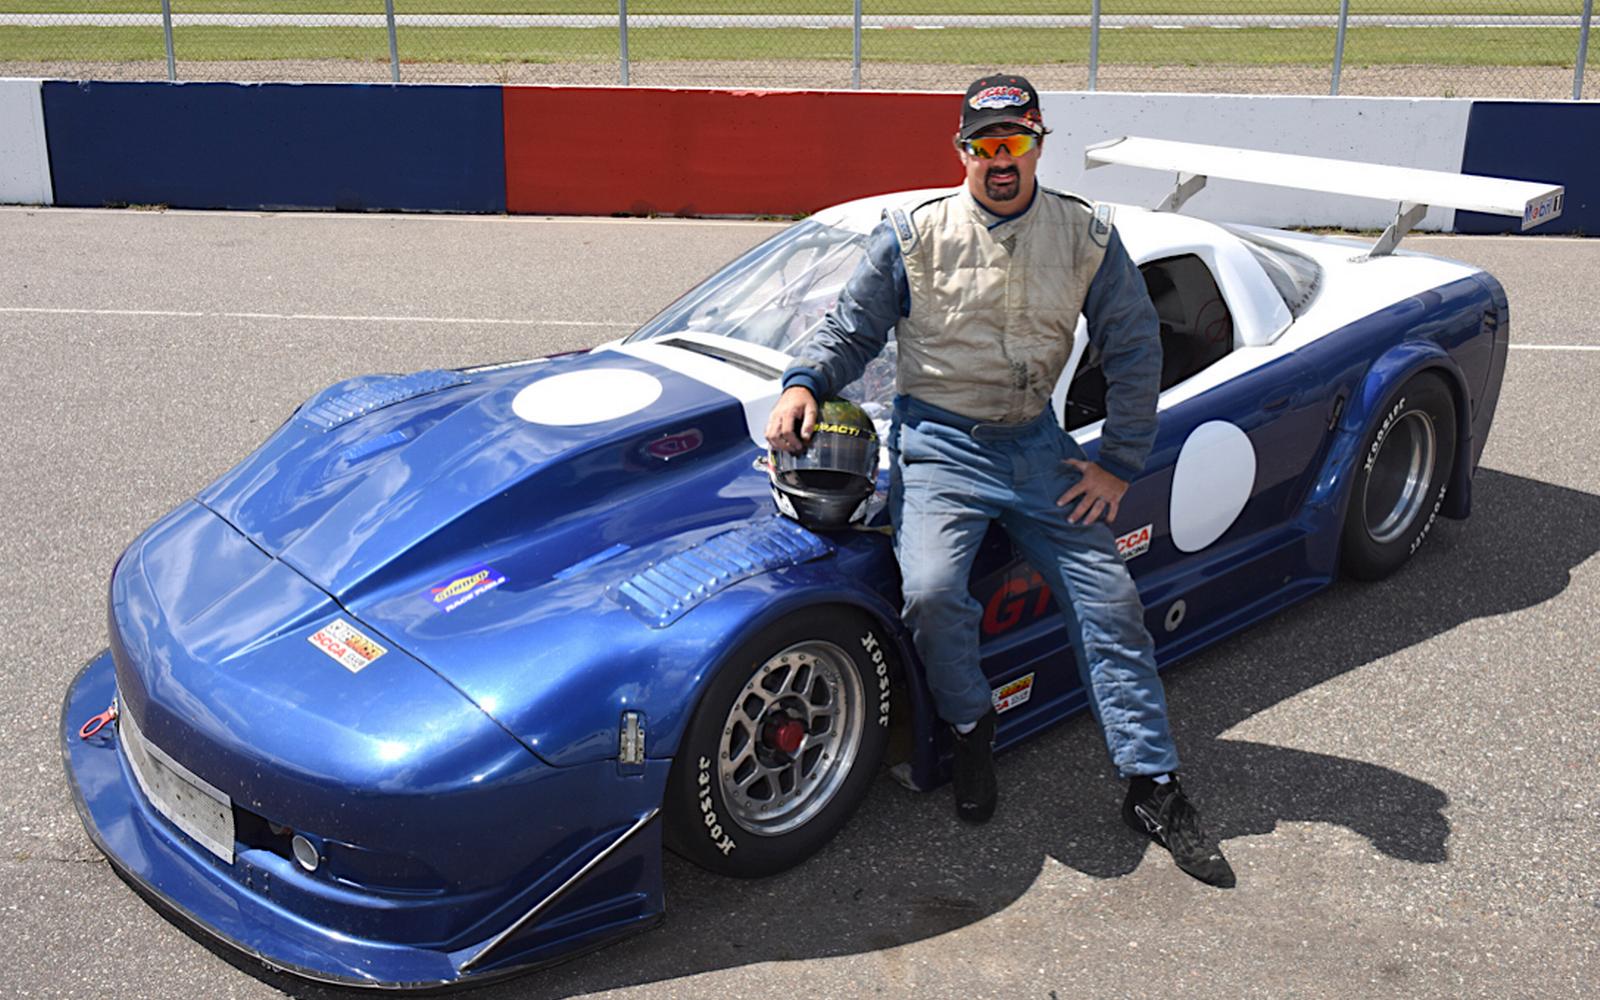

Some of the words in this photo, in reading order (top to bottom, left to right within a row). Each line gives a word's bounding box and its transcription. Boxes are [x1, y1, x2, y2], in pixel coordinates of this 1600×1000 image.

[1524, 196, 1553, 223] Mobil
[1116, 528, 1149, 553] CCA
[312, 631, 347, 658] SCCA
[861, 631, 892, 728] Hoosier
[698, 756, 737, 856] Hoosier
